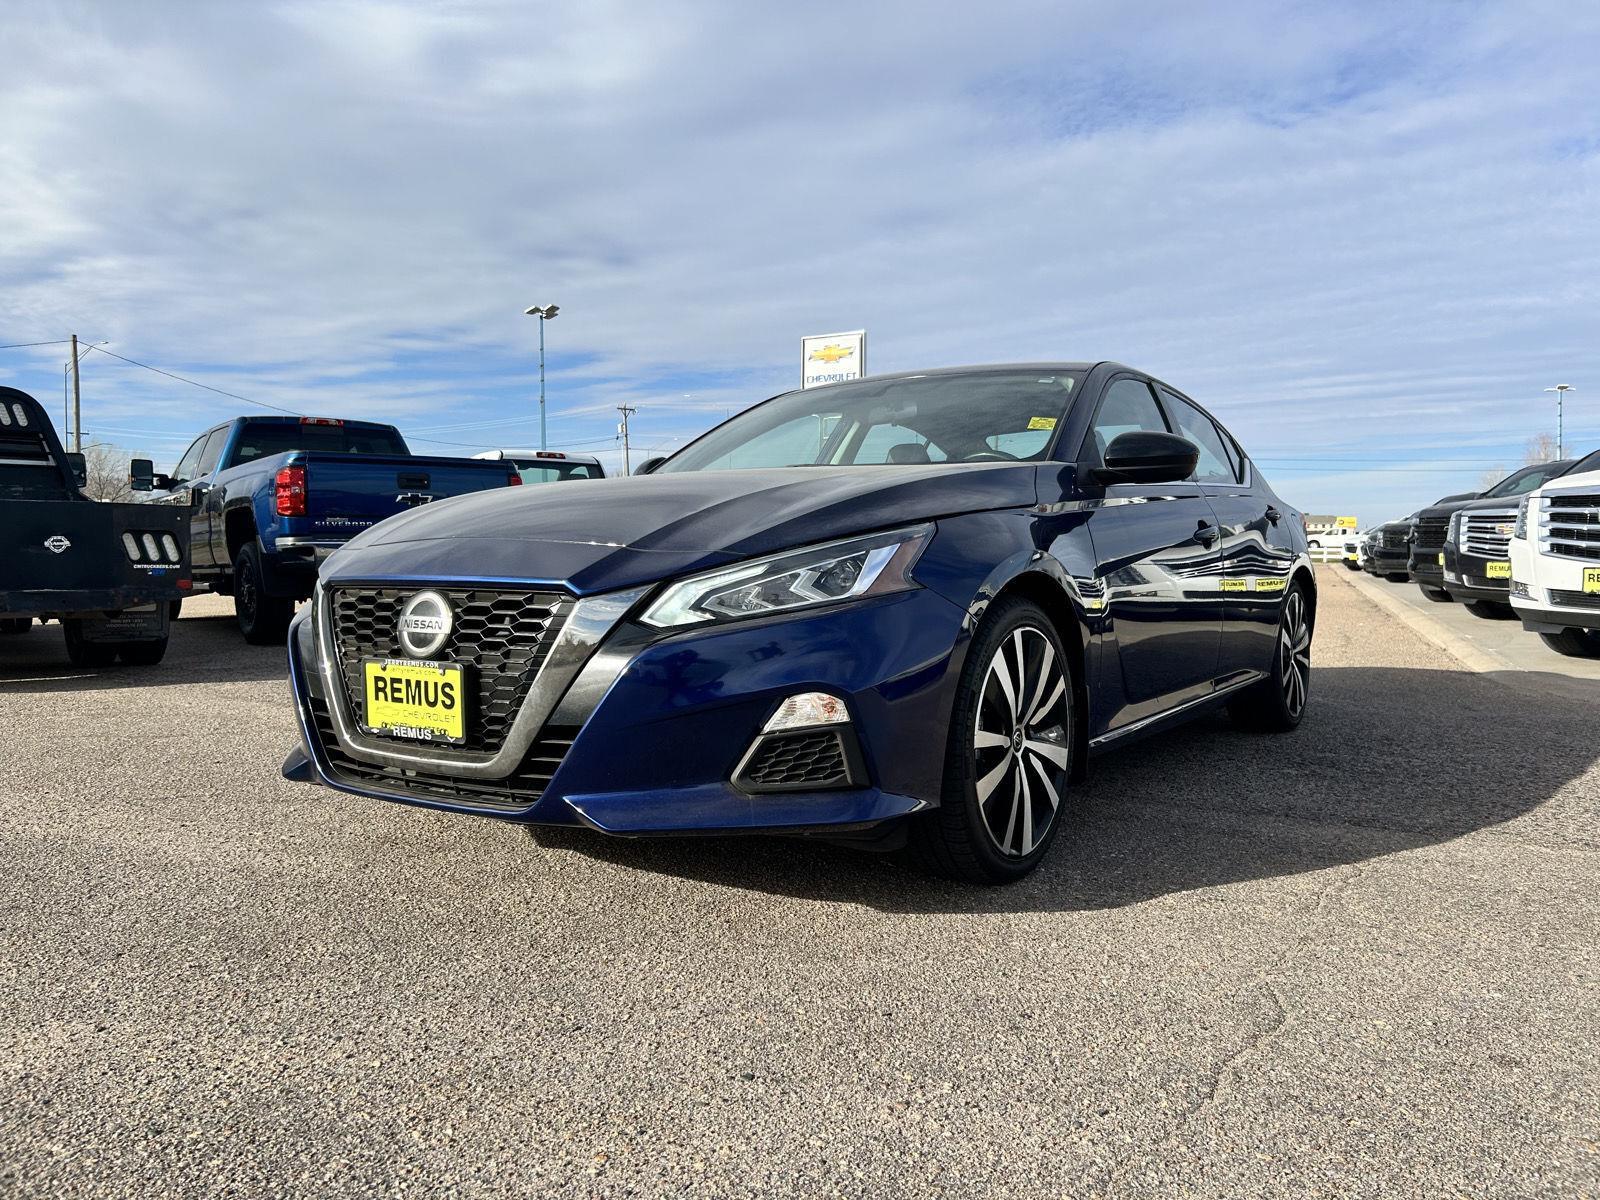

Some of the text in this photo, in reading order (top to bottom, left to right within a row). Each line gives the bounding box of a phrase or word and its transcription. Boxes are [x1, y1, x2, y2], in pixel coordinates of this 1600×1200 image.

[806, 372, 856, 383] CHEVROLET
[403, 619, 443, 630] NISSAN
[373, 675, 455, 709] REMUS
[403, 709, 456, 723] CHEVROLET
[393, 726, 432, 740] REMUS
